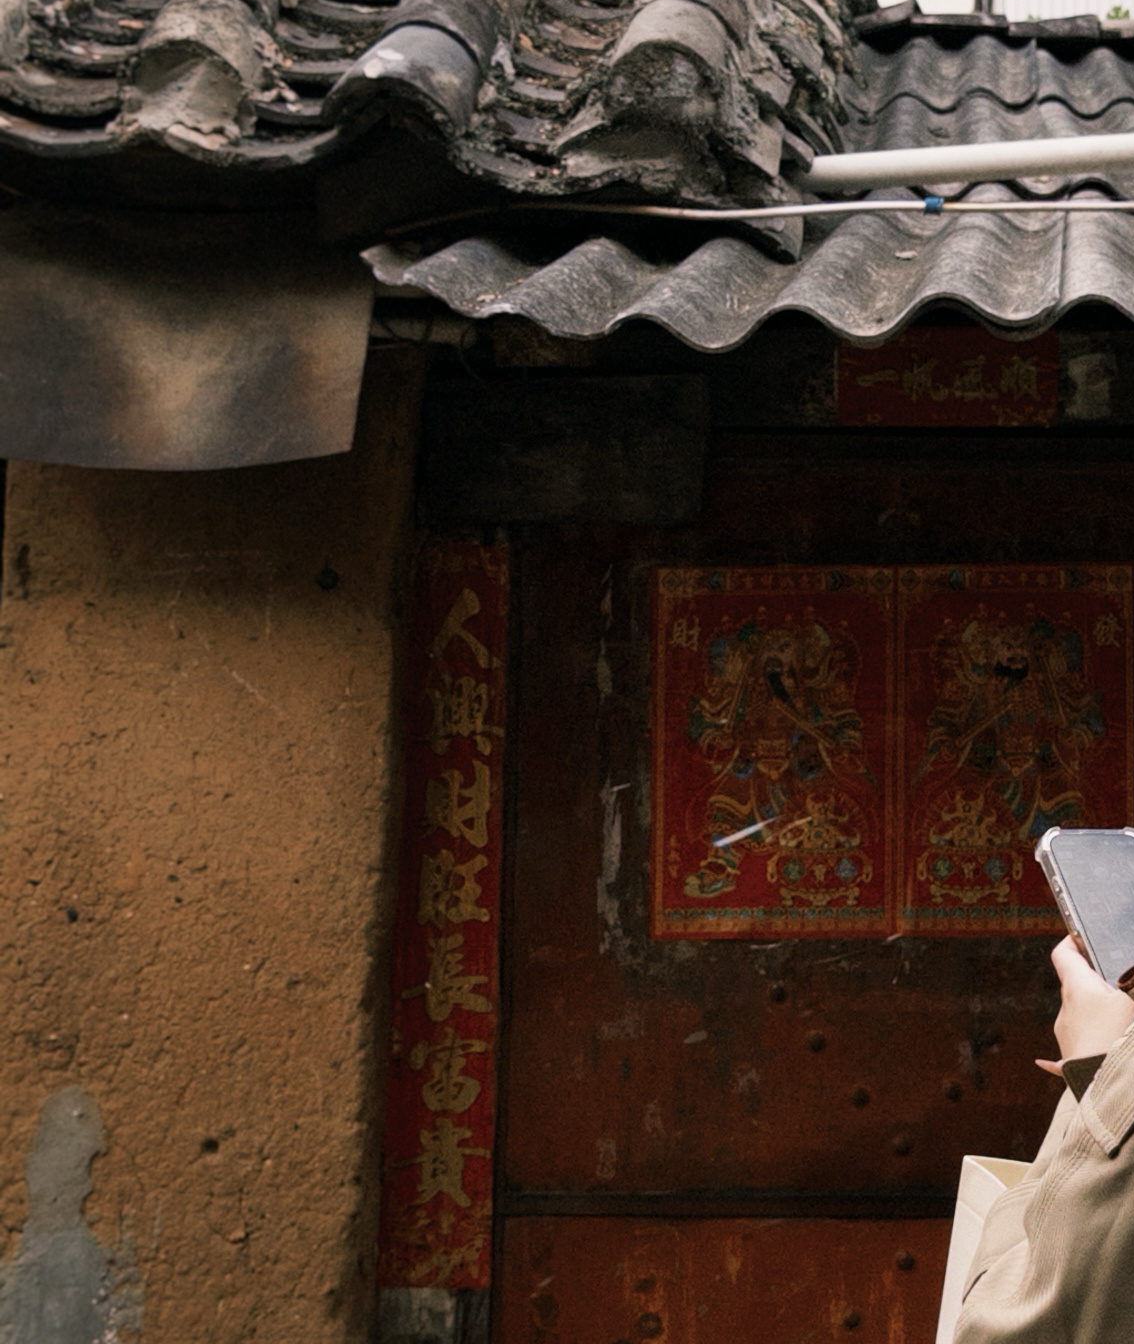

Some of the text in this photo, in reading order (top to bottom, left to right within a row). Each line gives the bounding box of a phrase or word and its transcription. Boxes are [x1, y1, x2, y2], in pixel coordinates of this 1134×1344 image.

[394, 587, 504, 1208] 人興財旺長富貴
